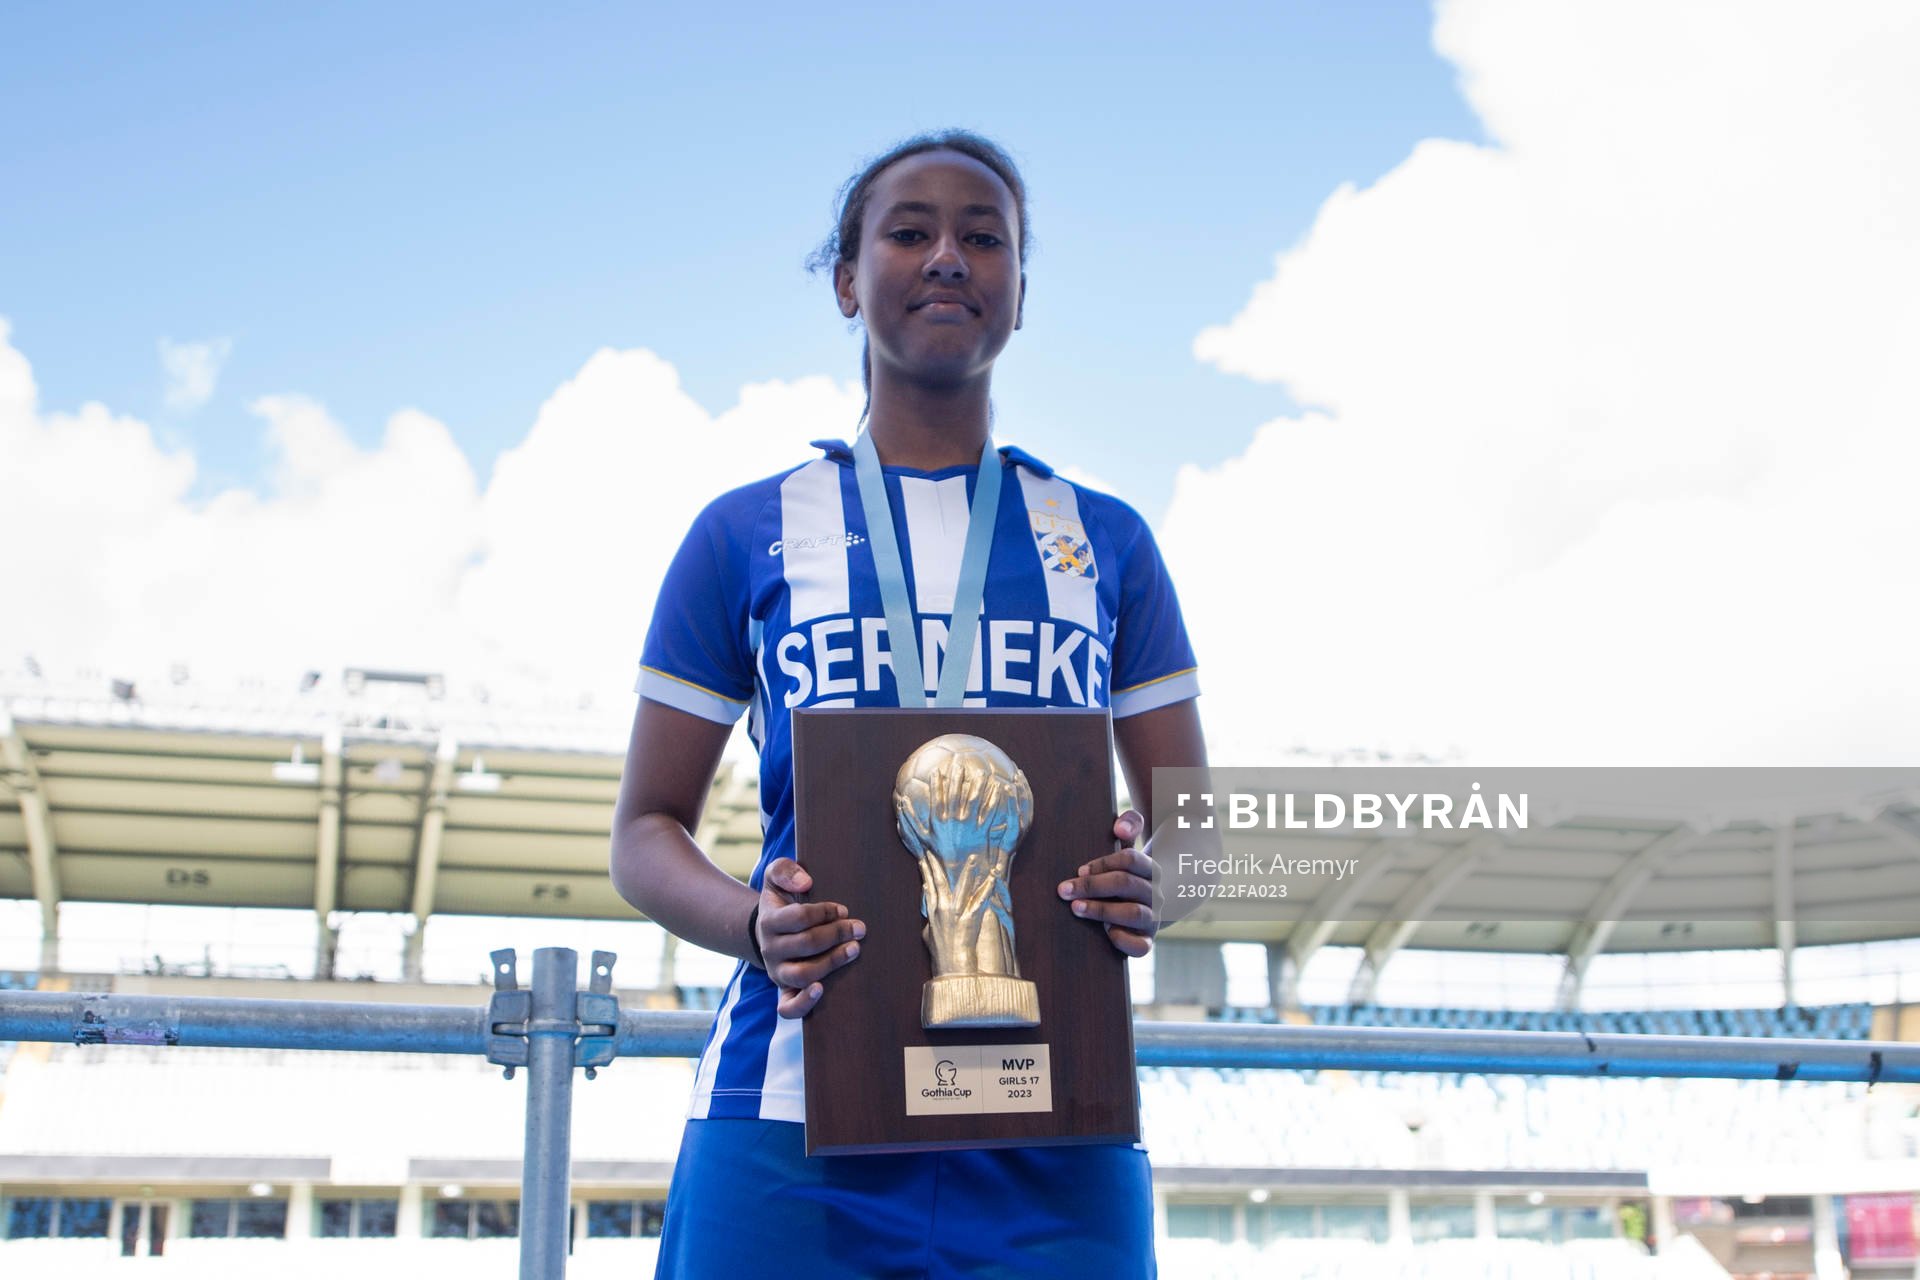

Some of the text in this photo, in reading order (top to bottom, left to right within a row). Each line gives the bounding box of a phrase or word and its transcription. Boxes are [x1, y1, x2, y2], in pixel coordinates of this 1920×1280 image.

[768, 534, 844, 557] CRAFT
[776, 617, 1108, 709] SERNEKE
[1002, 1058, 1035, 1071] MVP
[999, 1076, 1039, 1086] GIRLS 17
[921, 1087, 952, 1098] Gothia
[953, 1087, 972, 1099] Cup
[1007, 1089, 1032, 1098] 2023
